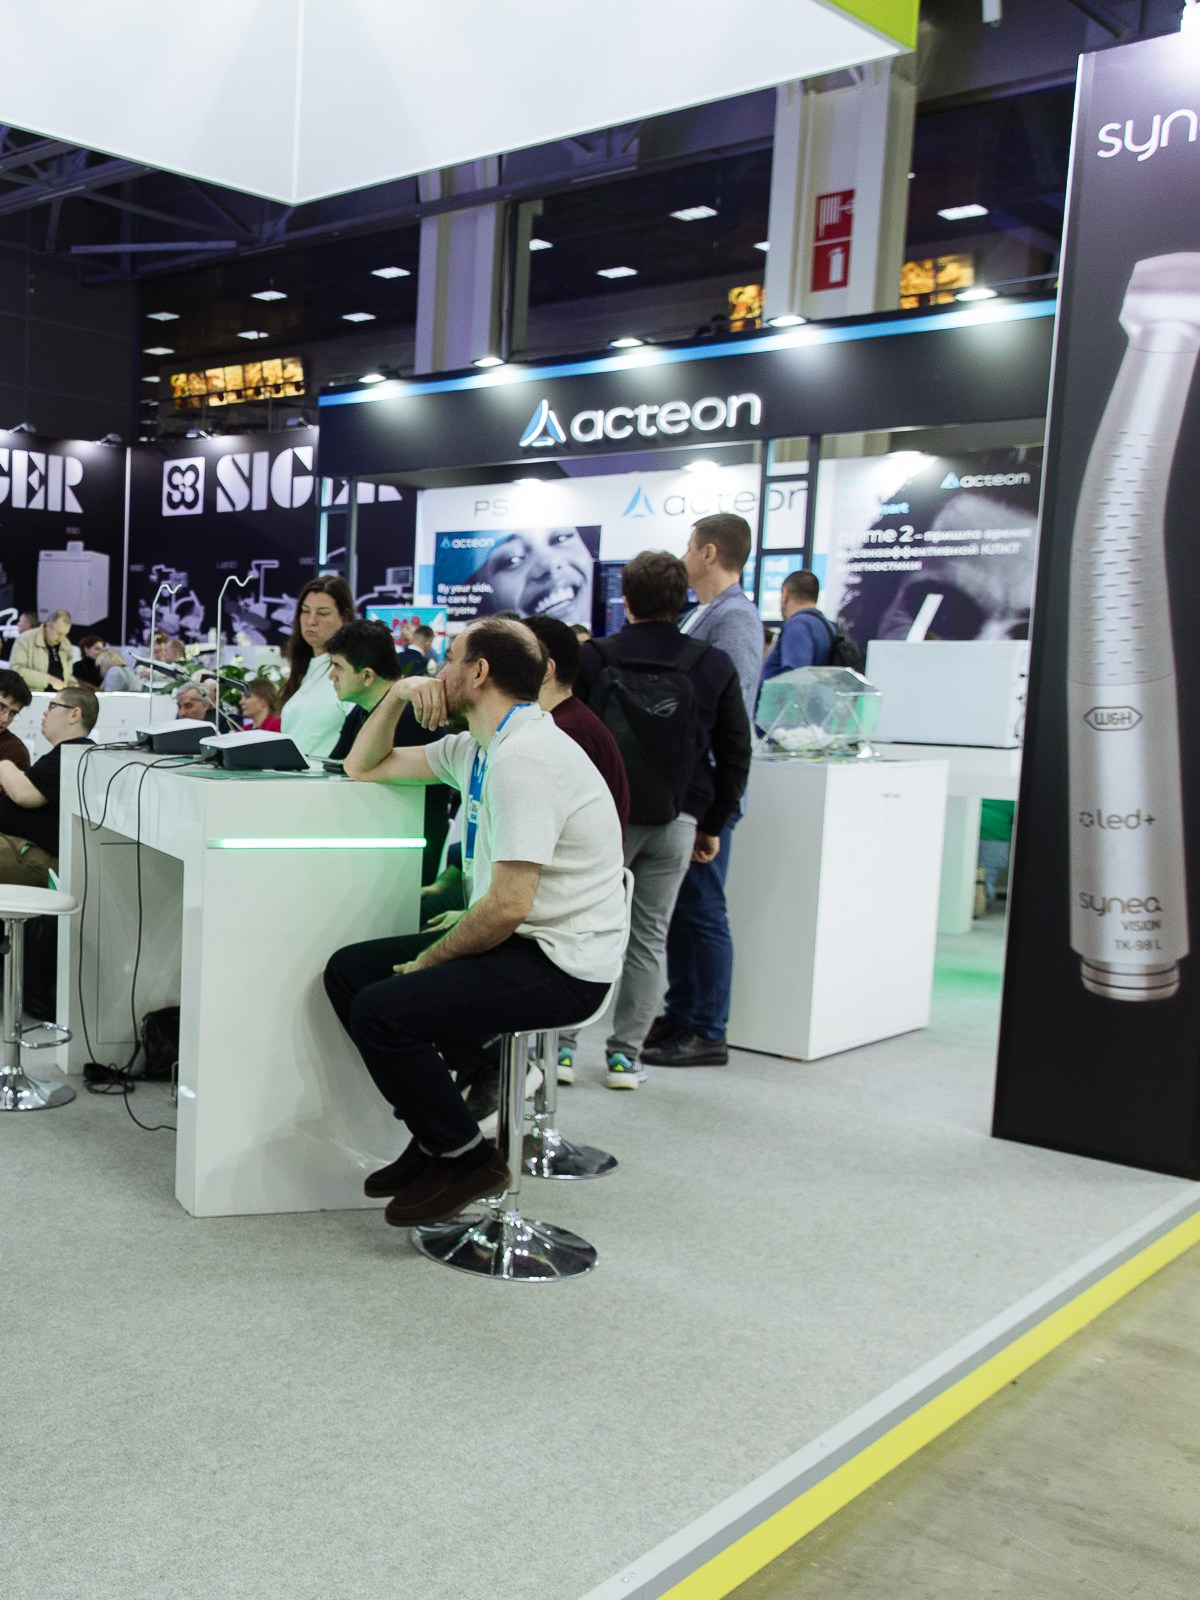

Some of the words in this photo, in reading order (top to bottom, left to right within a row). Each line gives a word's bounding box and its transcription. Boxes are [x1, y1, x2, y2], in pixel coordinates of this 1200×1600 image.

[1097, 108, 1200, 162] syn
[570, 391, 762, 443] acteon
[960, 472, 1031, 489] acteon
[451, 536, 495, 549] acteon
[1093, 709, 1133, 728] W&H
[1079, 892, 1163, 917] synea
[1121, 919, 1162, 932] VISION
